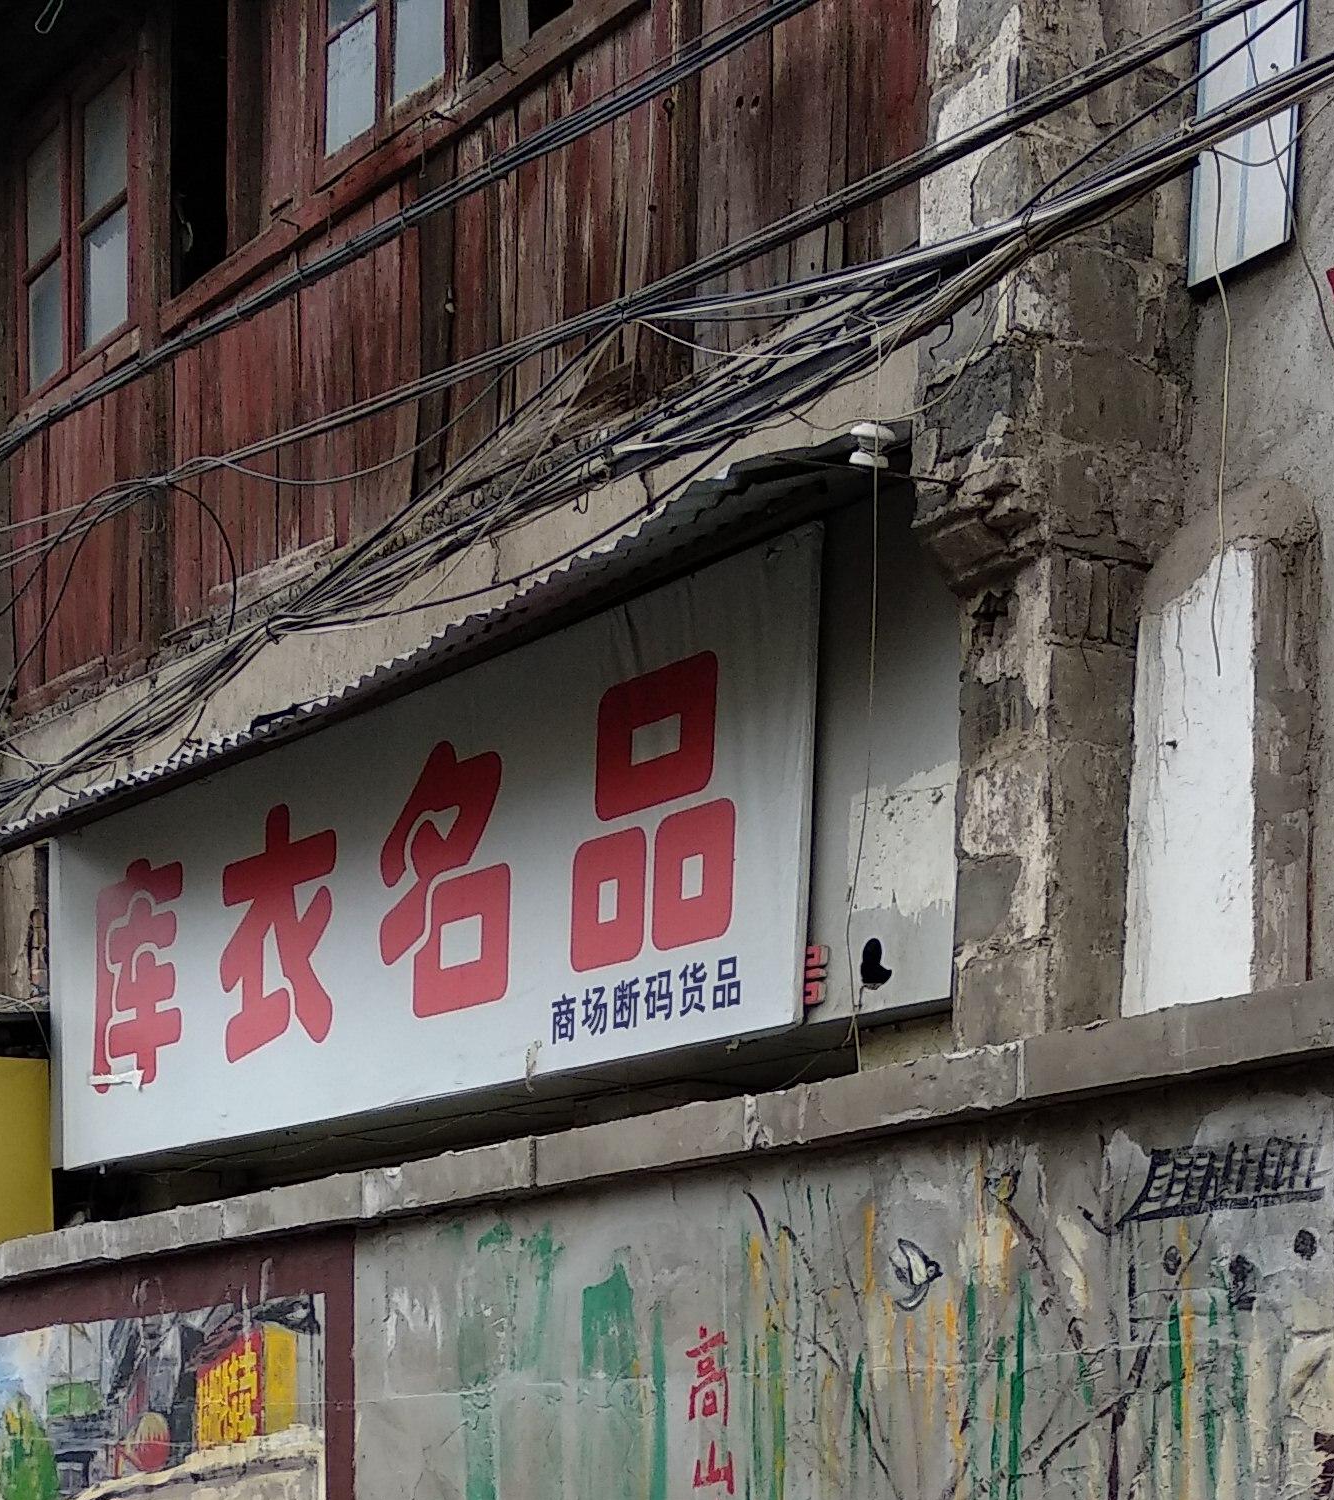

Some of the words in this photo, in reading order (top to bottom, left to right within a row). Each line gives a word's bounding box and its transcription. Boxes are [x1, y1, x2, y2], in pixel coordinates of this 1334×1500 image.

[94, 650, 736, 1095] 库衣名品
[551, 955, 742, 1046] 商场断码货品
